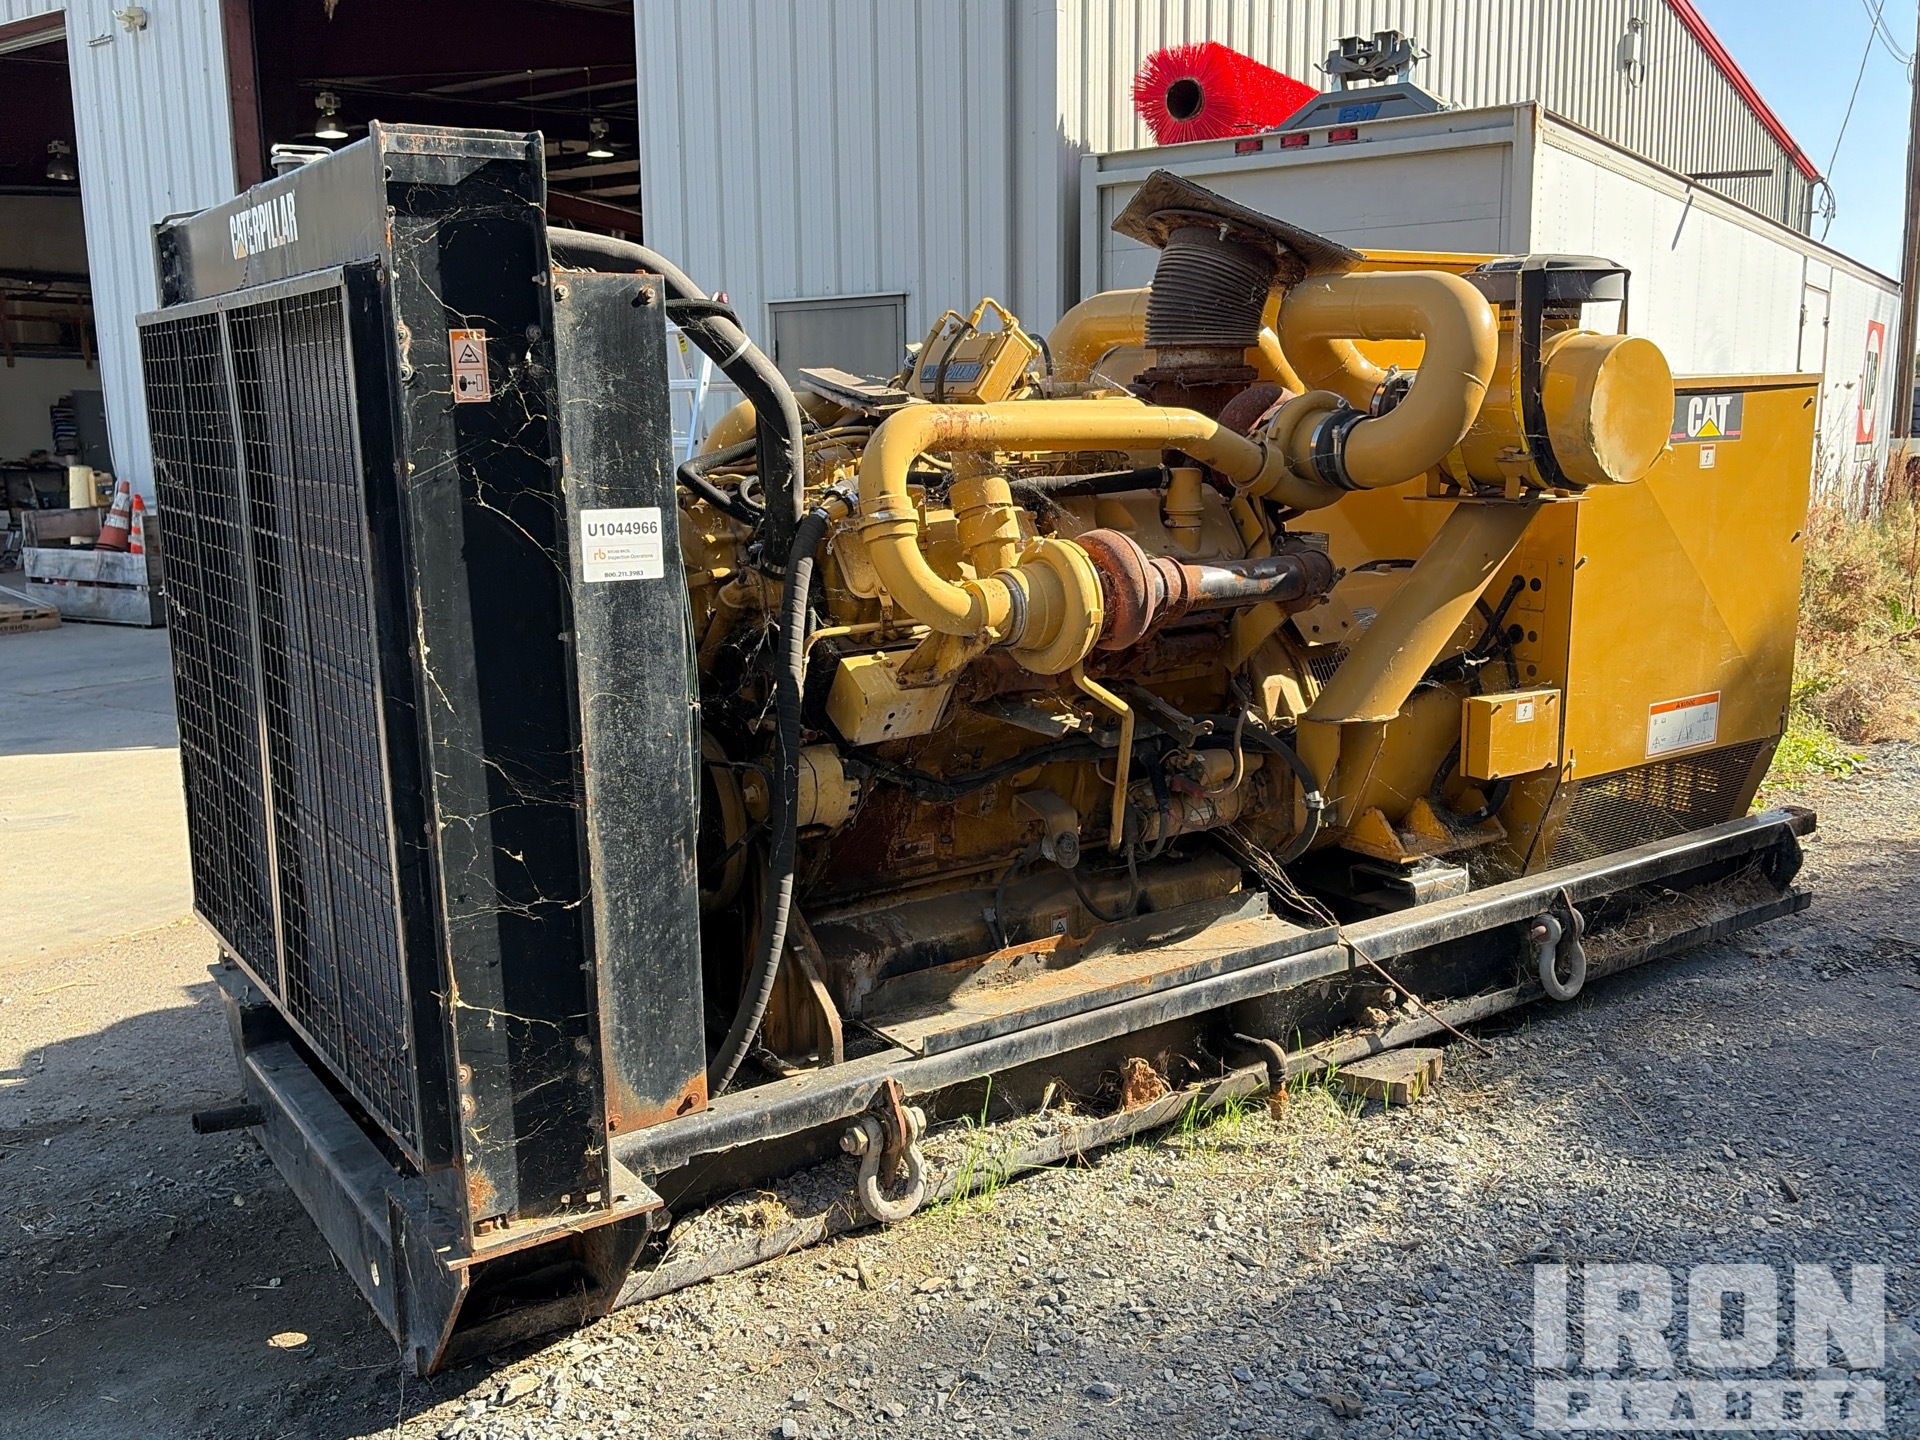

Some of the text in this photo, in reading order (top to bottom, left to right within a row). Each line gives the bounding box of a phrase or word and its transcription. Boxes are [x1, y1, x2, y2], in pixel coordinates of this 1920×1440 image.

[229, 192, 299, 260] CATERPILLAR
[1687, 396, 1731, 438] CAT
[587, 521, 658, 537] U1044966
